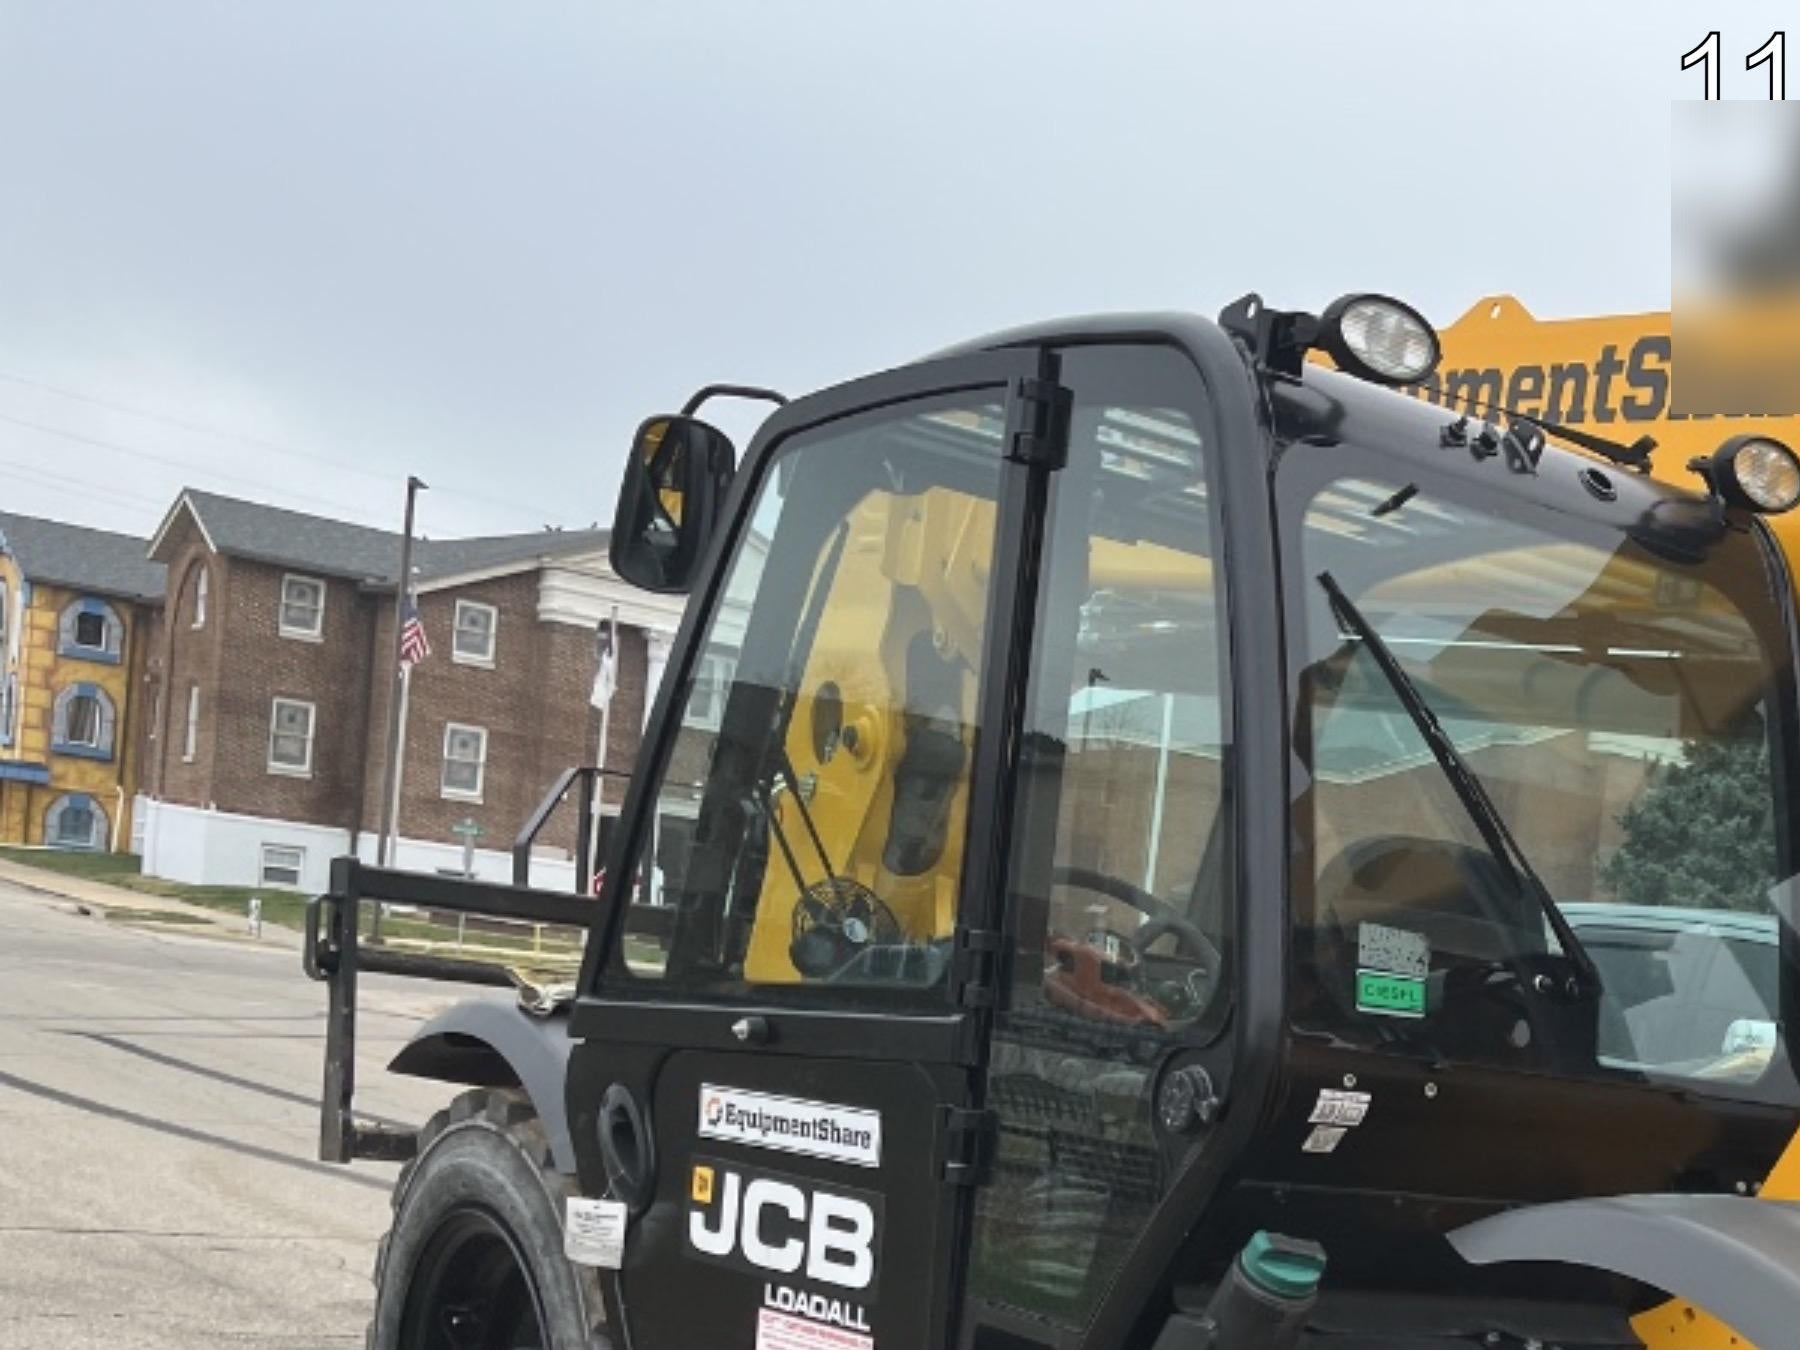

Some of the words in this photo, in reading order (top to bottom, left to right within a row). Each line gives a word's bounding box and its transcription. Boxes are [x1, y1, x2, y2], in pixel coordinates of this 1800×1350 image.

[725, 1102, 872, 1150] EquipmentShare
[689, 1171, 875, 1289] JCB
[764, 1282, 872, 1333] LOADALL
